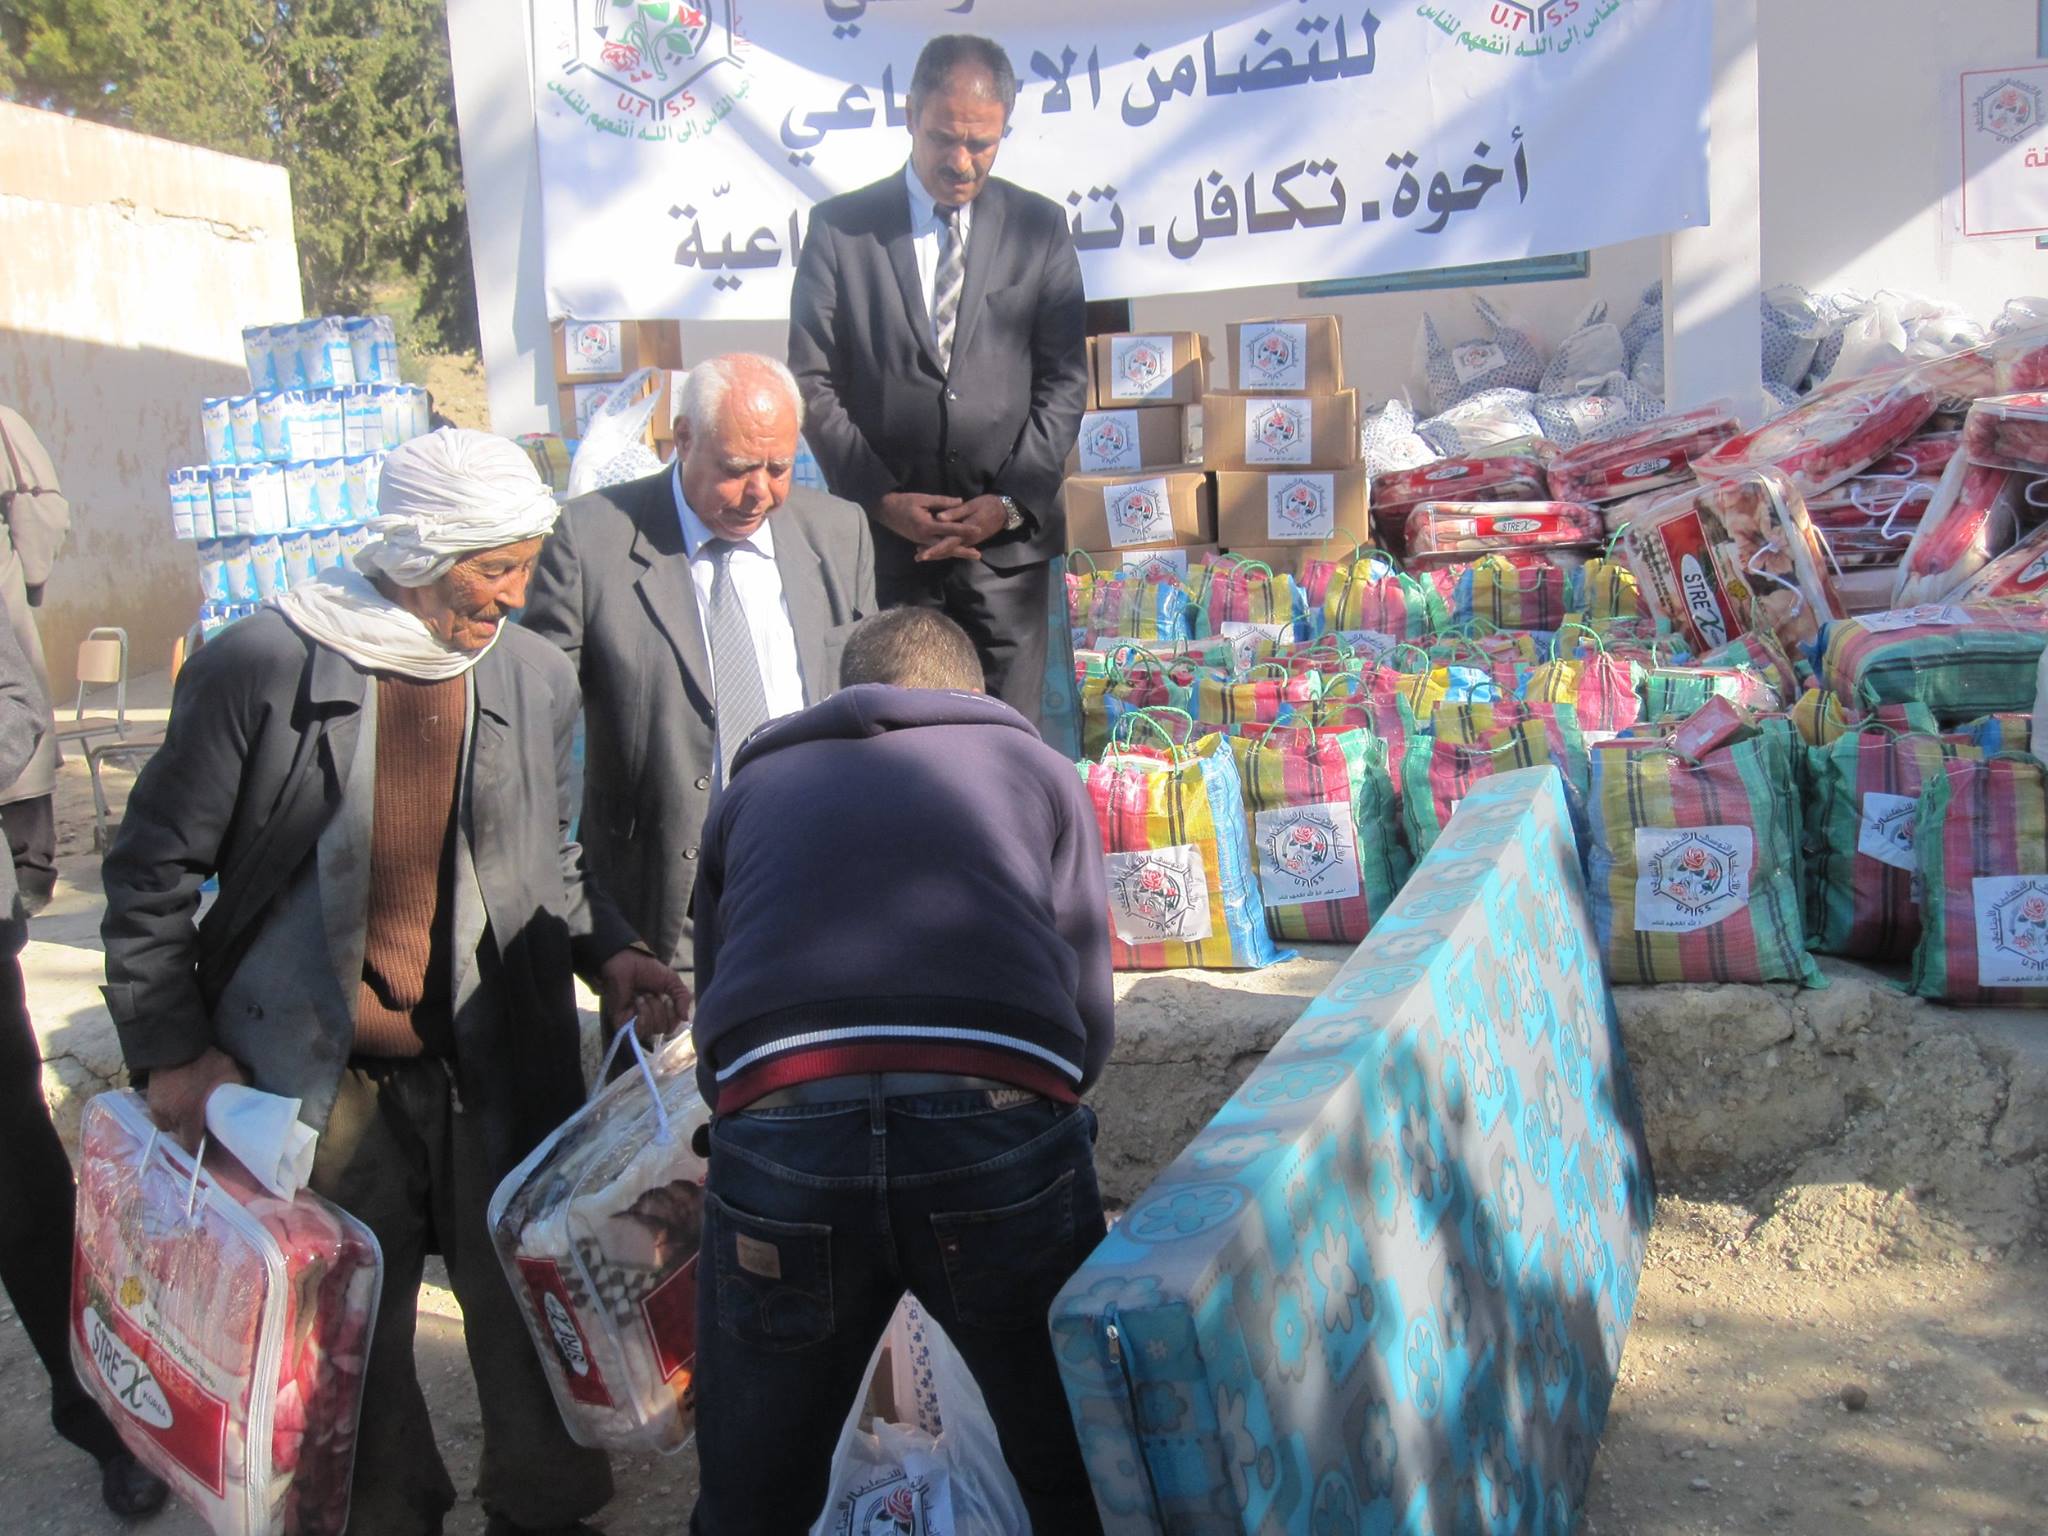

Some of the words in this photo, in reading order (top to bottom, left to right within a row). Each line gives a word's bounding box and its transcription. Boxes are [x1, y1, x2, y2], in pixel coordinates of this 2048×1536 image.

[617, 92, 650, 117] U.T
[665, 90, 696, 118] S.S
[1120, 7, 1382, 127] للتضامن
[1683, 572, 1725, 635] STREX
[92, 1320, 152, 1408] STREX
